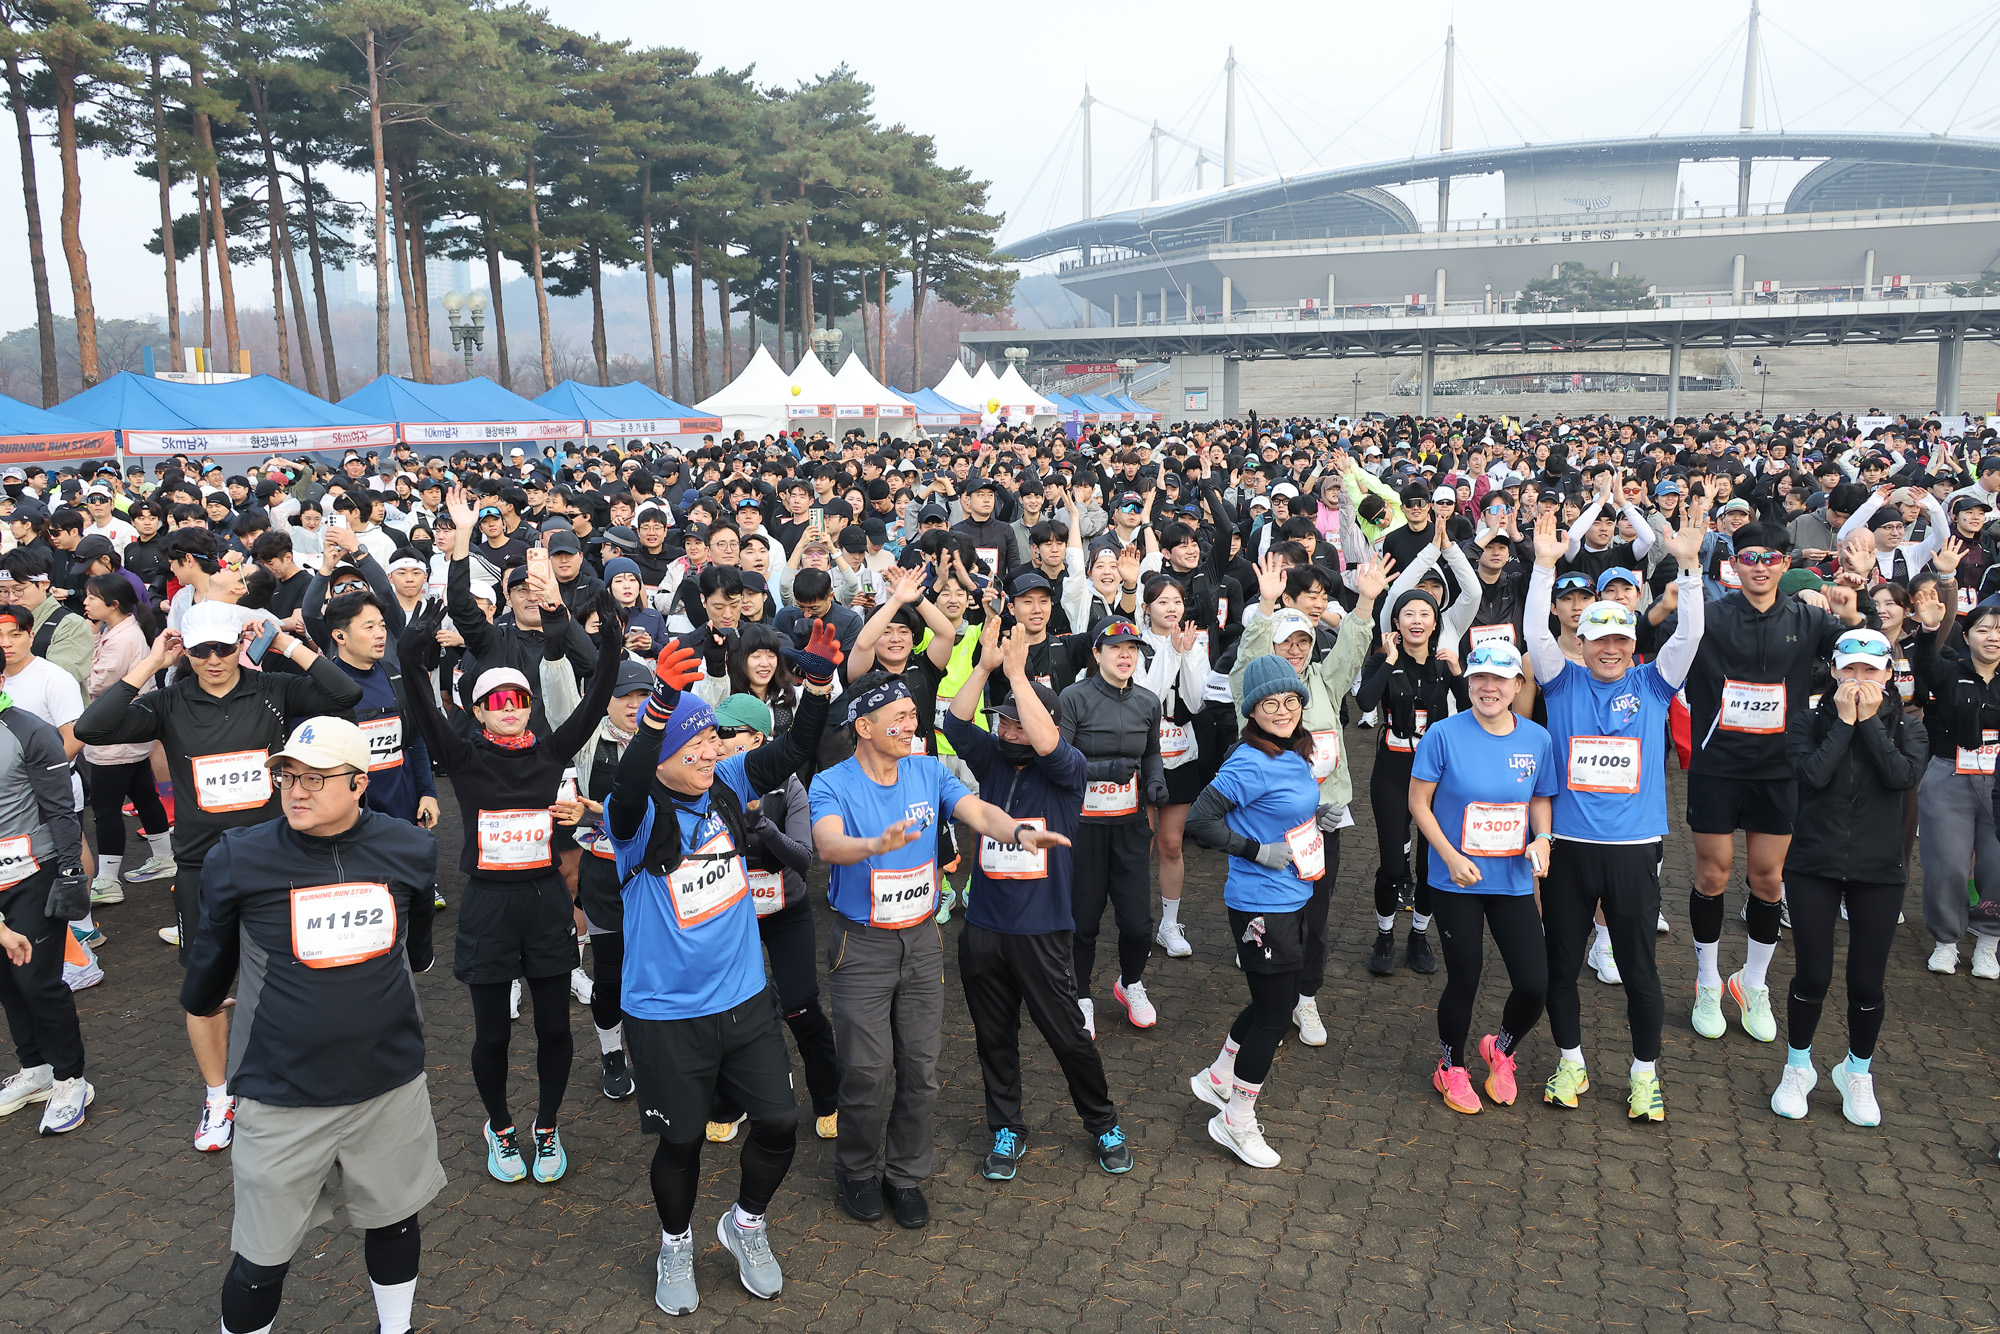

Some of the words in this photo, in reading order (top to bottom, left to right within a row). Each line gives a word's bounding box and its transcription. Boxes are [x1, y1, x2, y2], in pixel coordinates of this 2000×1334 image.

[424, 426, 458, 438] 10km남자
[485, 426, 518, 438] 현장배부처
[162, 436, 209, 450] 5km남자
[250, 434, 298, 449] 현장배부처
[332, 430, 368, 444] 5km여자
[0, 442, 46, 454] BURNING
[48, 441, 70, 452] RUN
[1730, 700, 1780, 712] M1327
[199, 758, 223, 766] BURNING
[1578, 755, 1631, 768] M1009
[206, 770, 262, 786] M1912
[1090, 783, 1132, 794] W3619
[1472, 820, 1520, 832] W3007
[489, 828, 544, 844] W3410
[988, 841, 1024, 852] M100
[682, 857, 732, 894] M1007
[300, 892, 332, 902] BURNING
[334, 890, 350, 898] RUN
[882, 882, 930, 902] M1006
[307, 908, 384, 930] M1152
